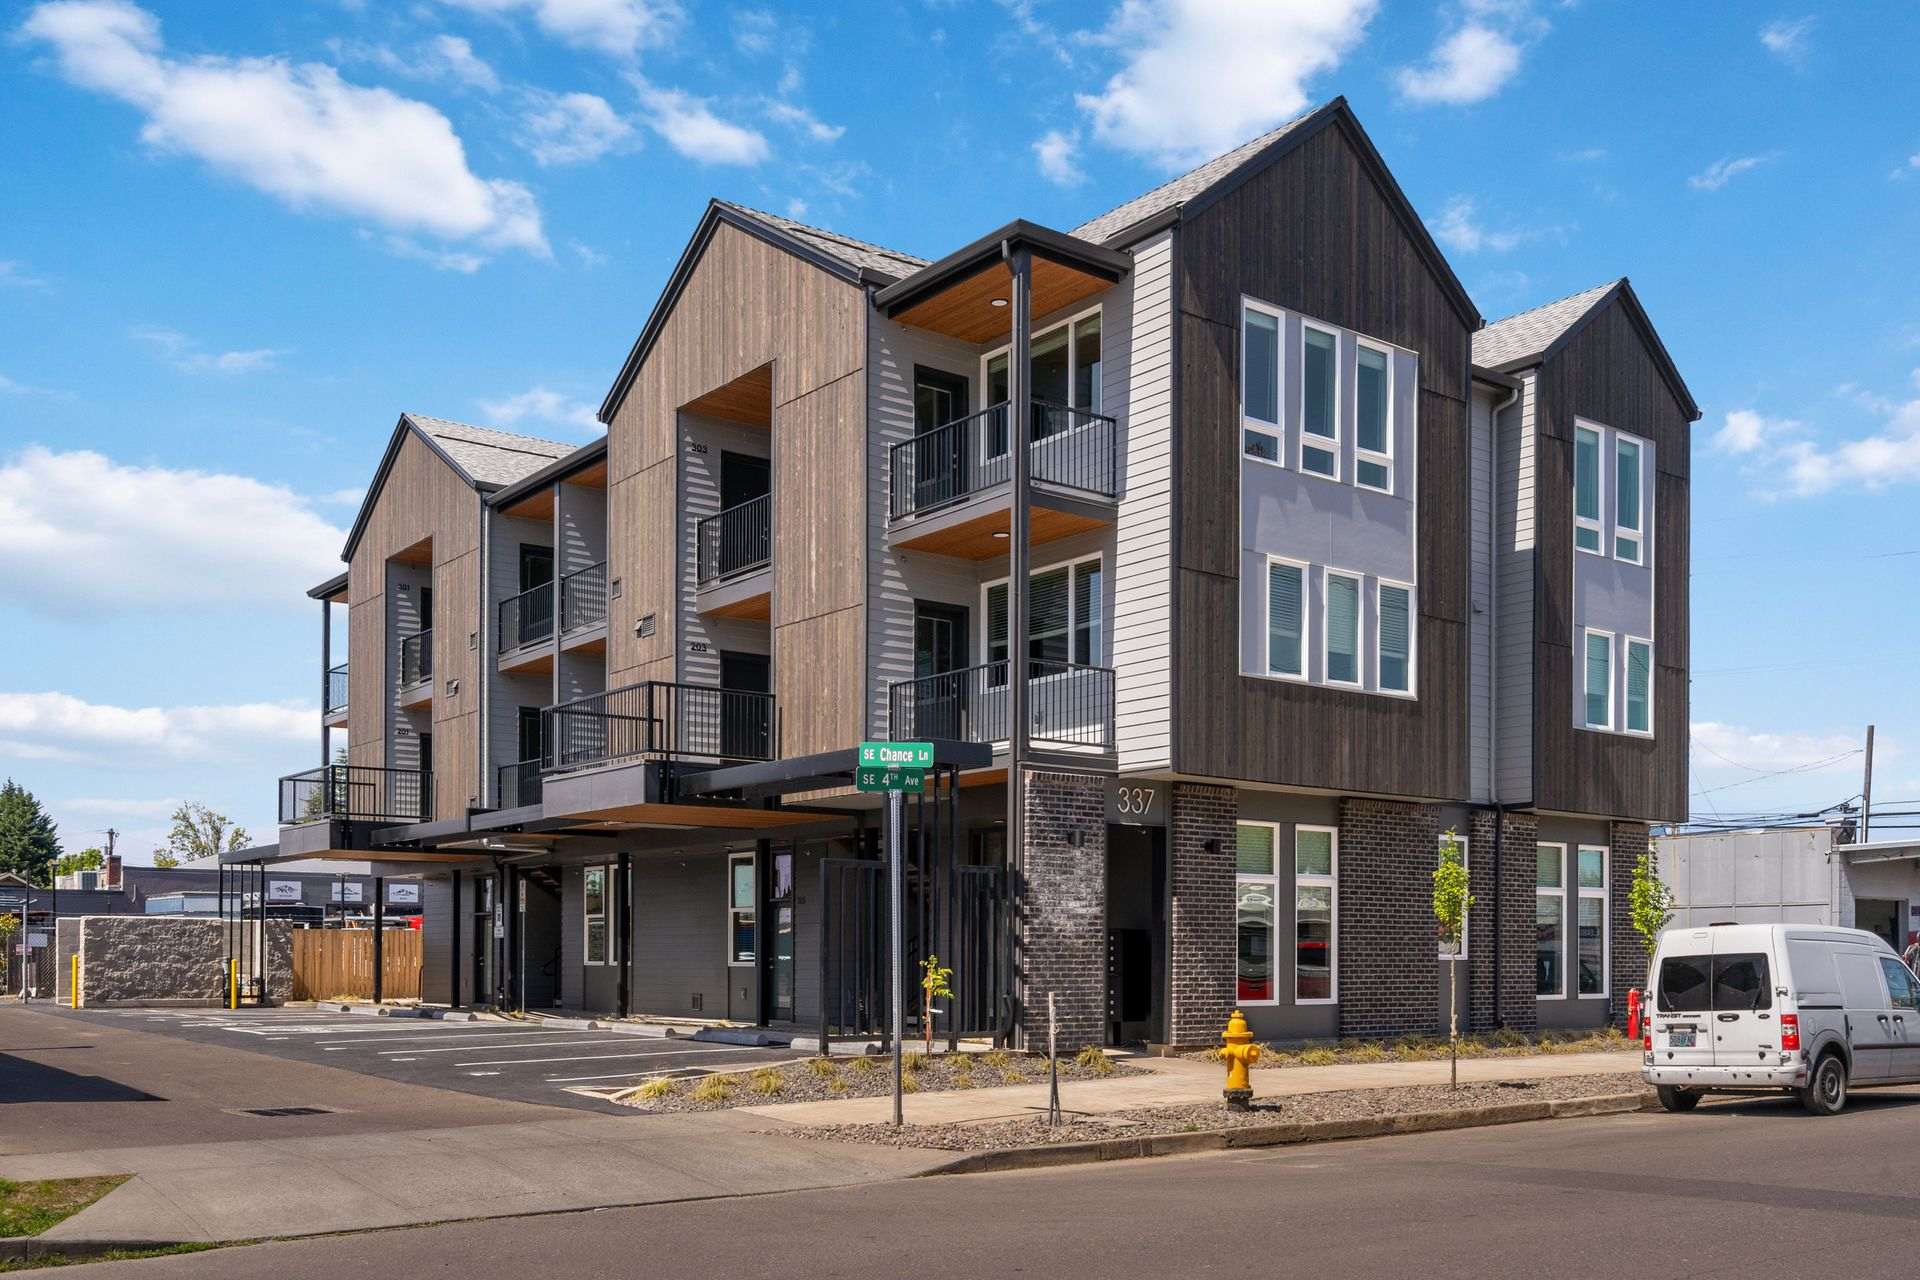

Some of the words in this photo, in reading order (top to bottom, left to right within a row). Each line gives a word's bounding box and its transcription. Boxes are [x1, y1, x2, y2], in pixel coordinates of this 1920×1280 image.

[691, 442, 708, 454] 303
[690, 641, 707, 652] 203
[864, 748, 875, 760] SE
[880, 747, 913, 762] Chance
[918, 750, 929, 760] Ln
[863, 774, 875, 785] SE
[882, 772, 898, 786] 4TH
[905, 776, 919, 786] Ave
[1117, 787, 1154, 815] 337
